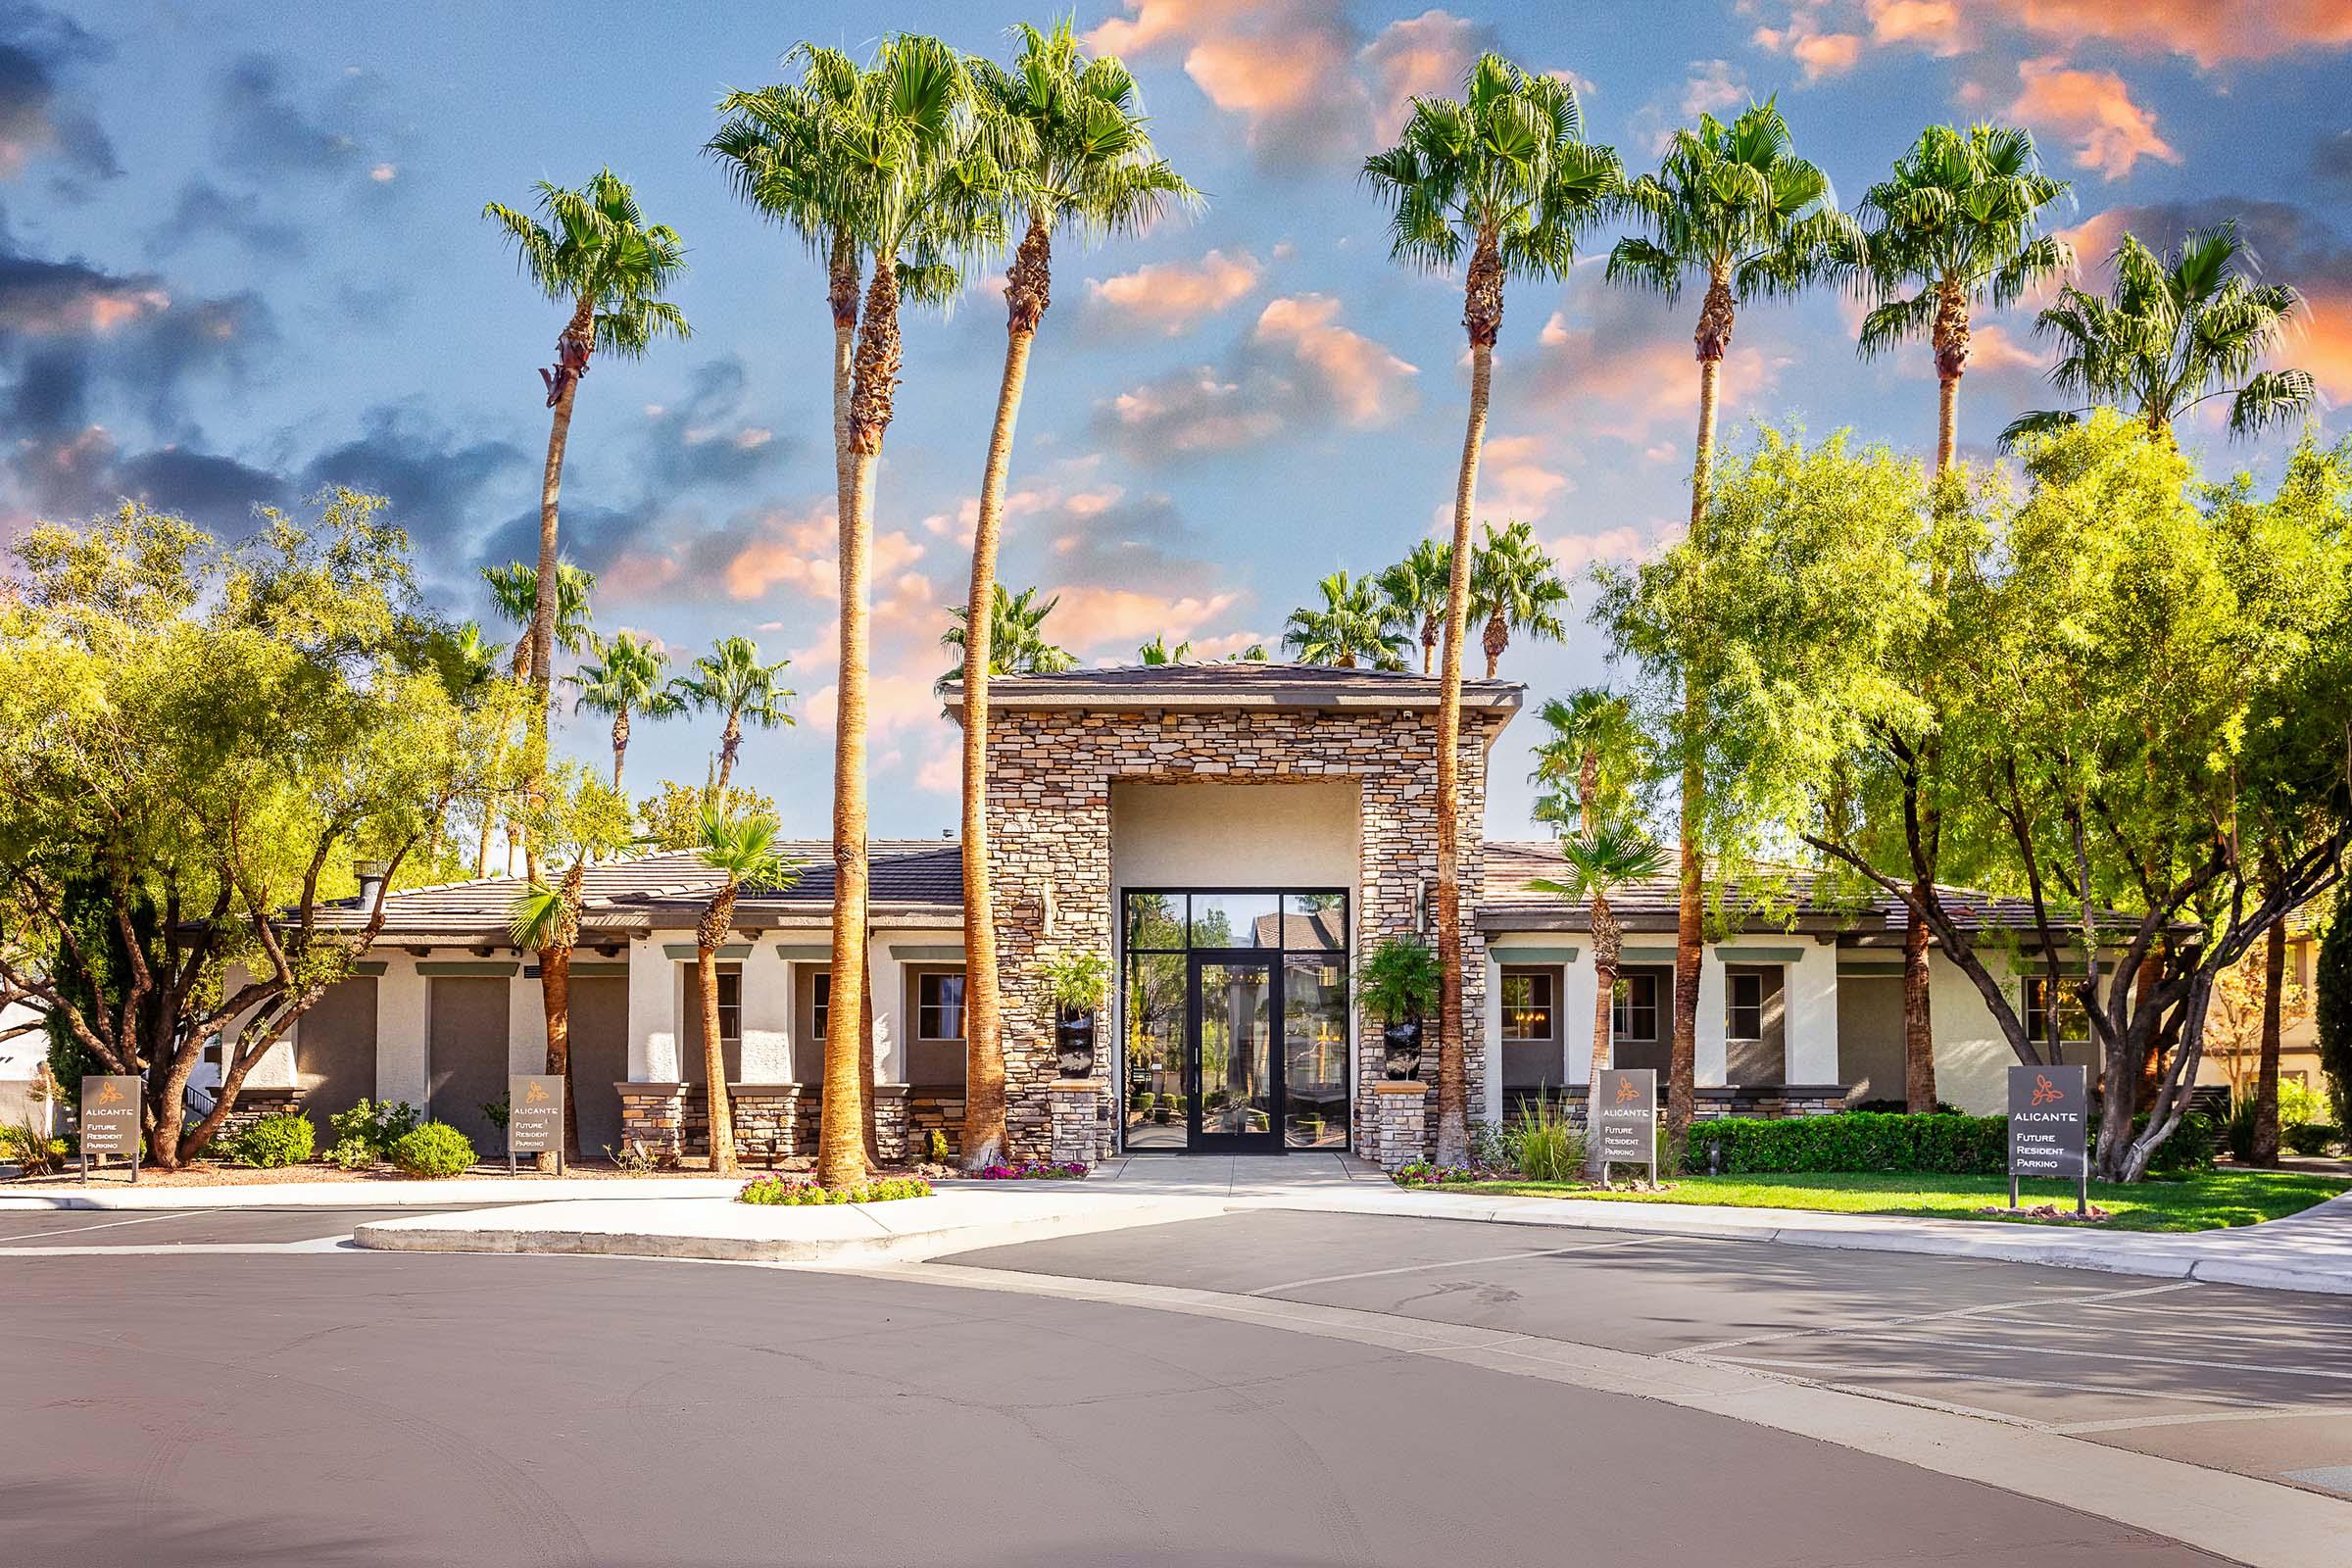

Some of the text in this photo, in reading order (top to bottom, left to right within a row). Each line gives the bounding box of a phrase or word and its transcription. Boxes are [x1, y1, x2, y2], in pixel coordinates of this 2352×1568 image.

[2014, 1112, 2079, 1122] ALICANTE
[1604, 1137, 1640, 1146] RESIDENT
[2016, 1133, 2056, 1143] FUTURE
[1604, 1148, 1636, 1156] PARKING
[2016, 1147, 2065, 1155] RESIDENT
[2016, 1158, 2059, 1168] PARKING
